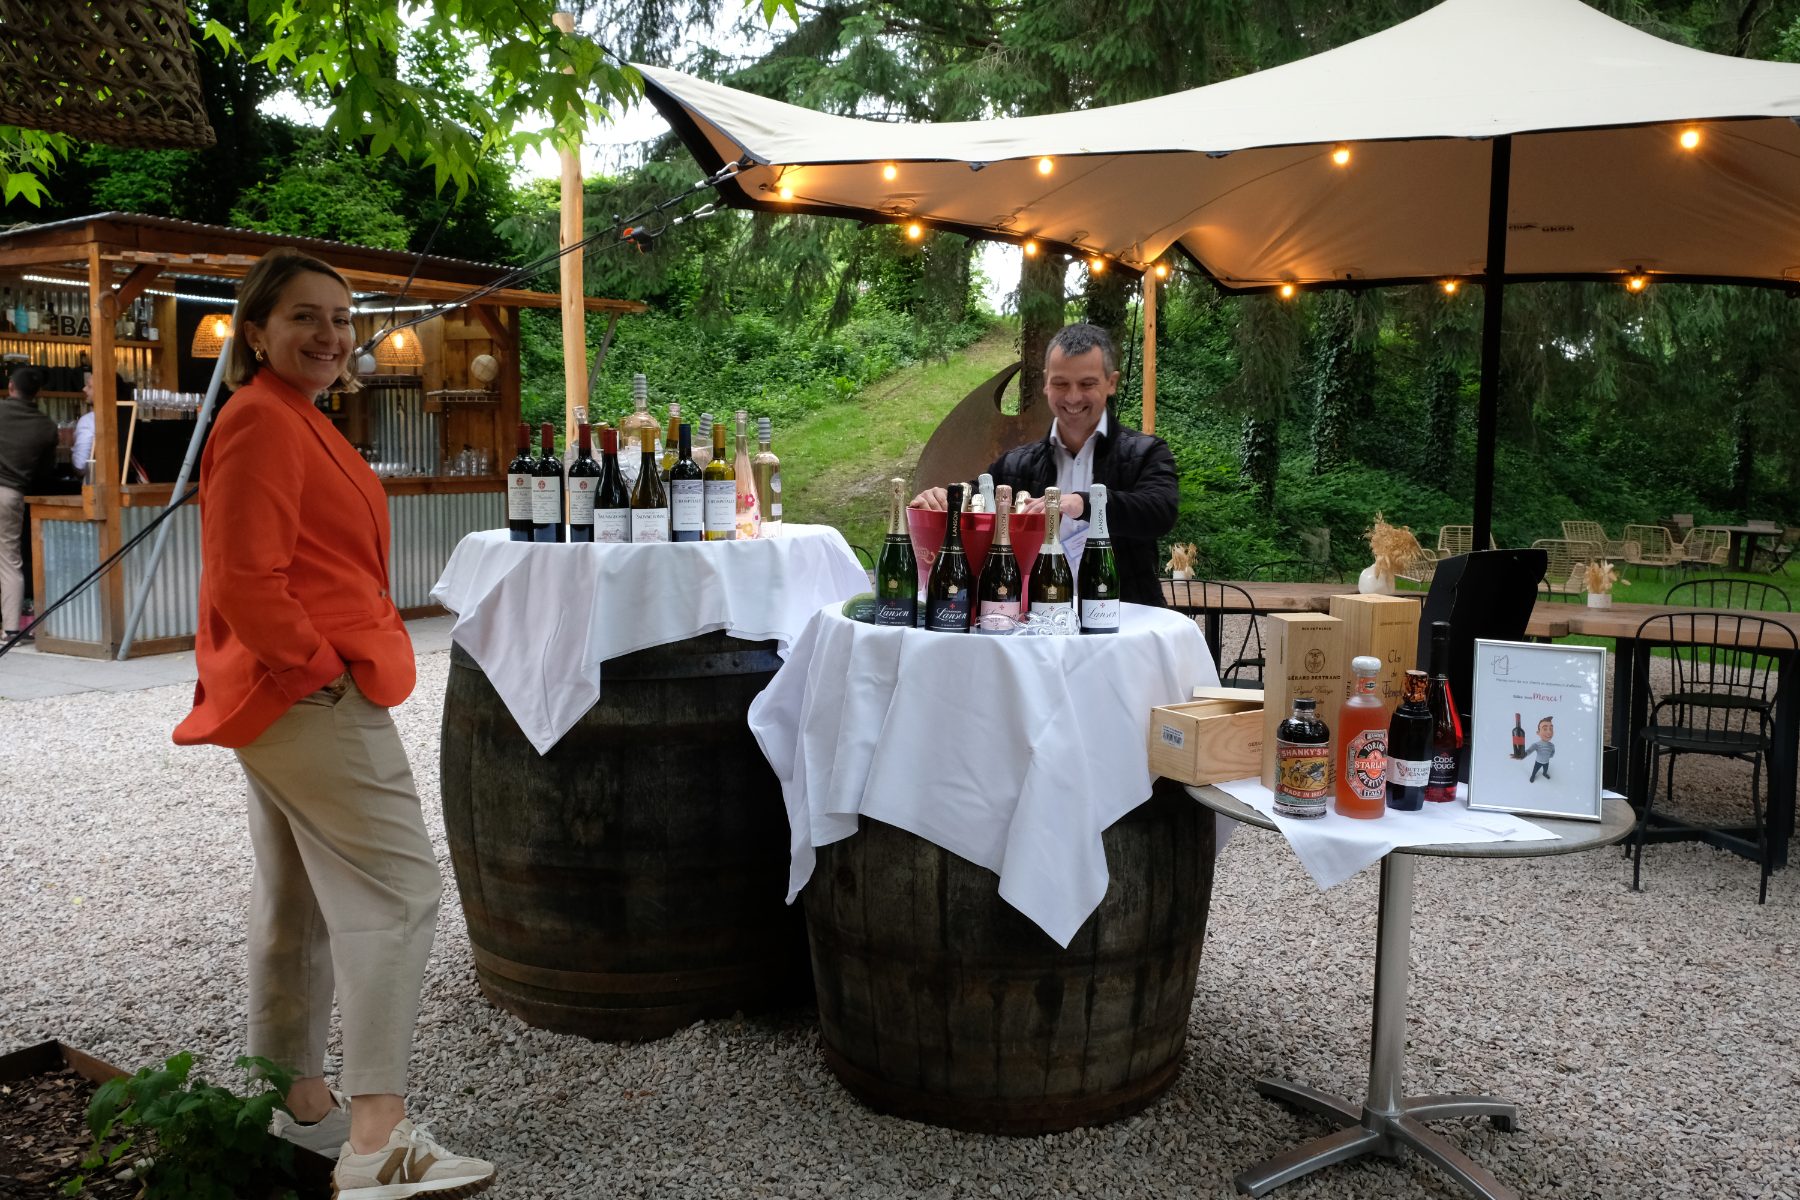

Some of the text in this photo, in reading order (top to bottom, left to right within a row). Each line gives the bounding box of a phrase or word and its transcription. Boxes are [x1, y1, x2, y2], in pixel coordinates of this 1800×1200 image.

[60, 315, 91, 337] BA
[879, 605, 909, 619] Lanson
[936, 607, 968, 622] Lanson
[1087, 606, 1118, 620] Lanson
[1281, 748, 1322, 757] SHANKY'S
[1364, 741, 1385, 752] TORINO
[1433, 755, 1453, 764] CODE
[1432, 761, 1456, 772] ROUGE
[1358, 771, 1386, 787] APERITIVO
[1284, 786, 1301, 797] MADE
